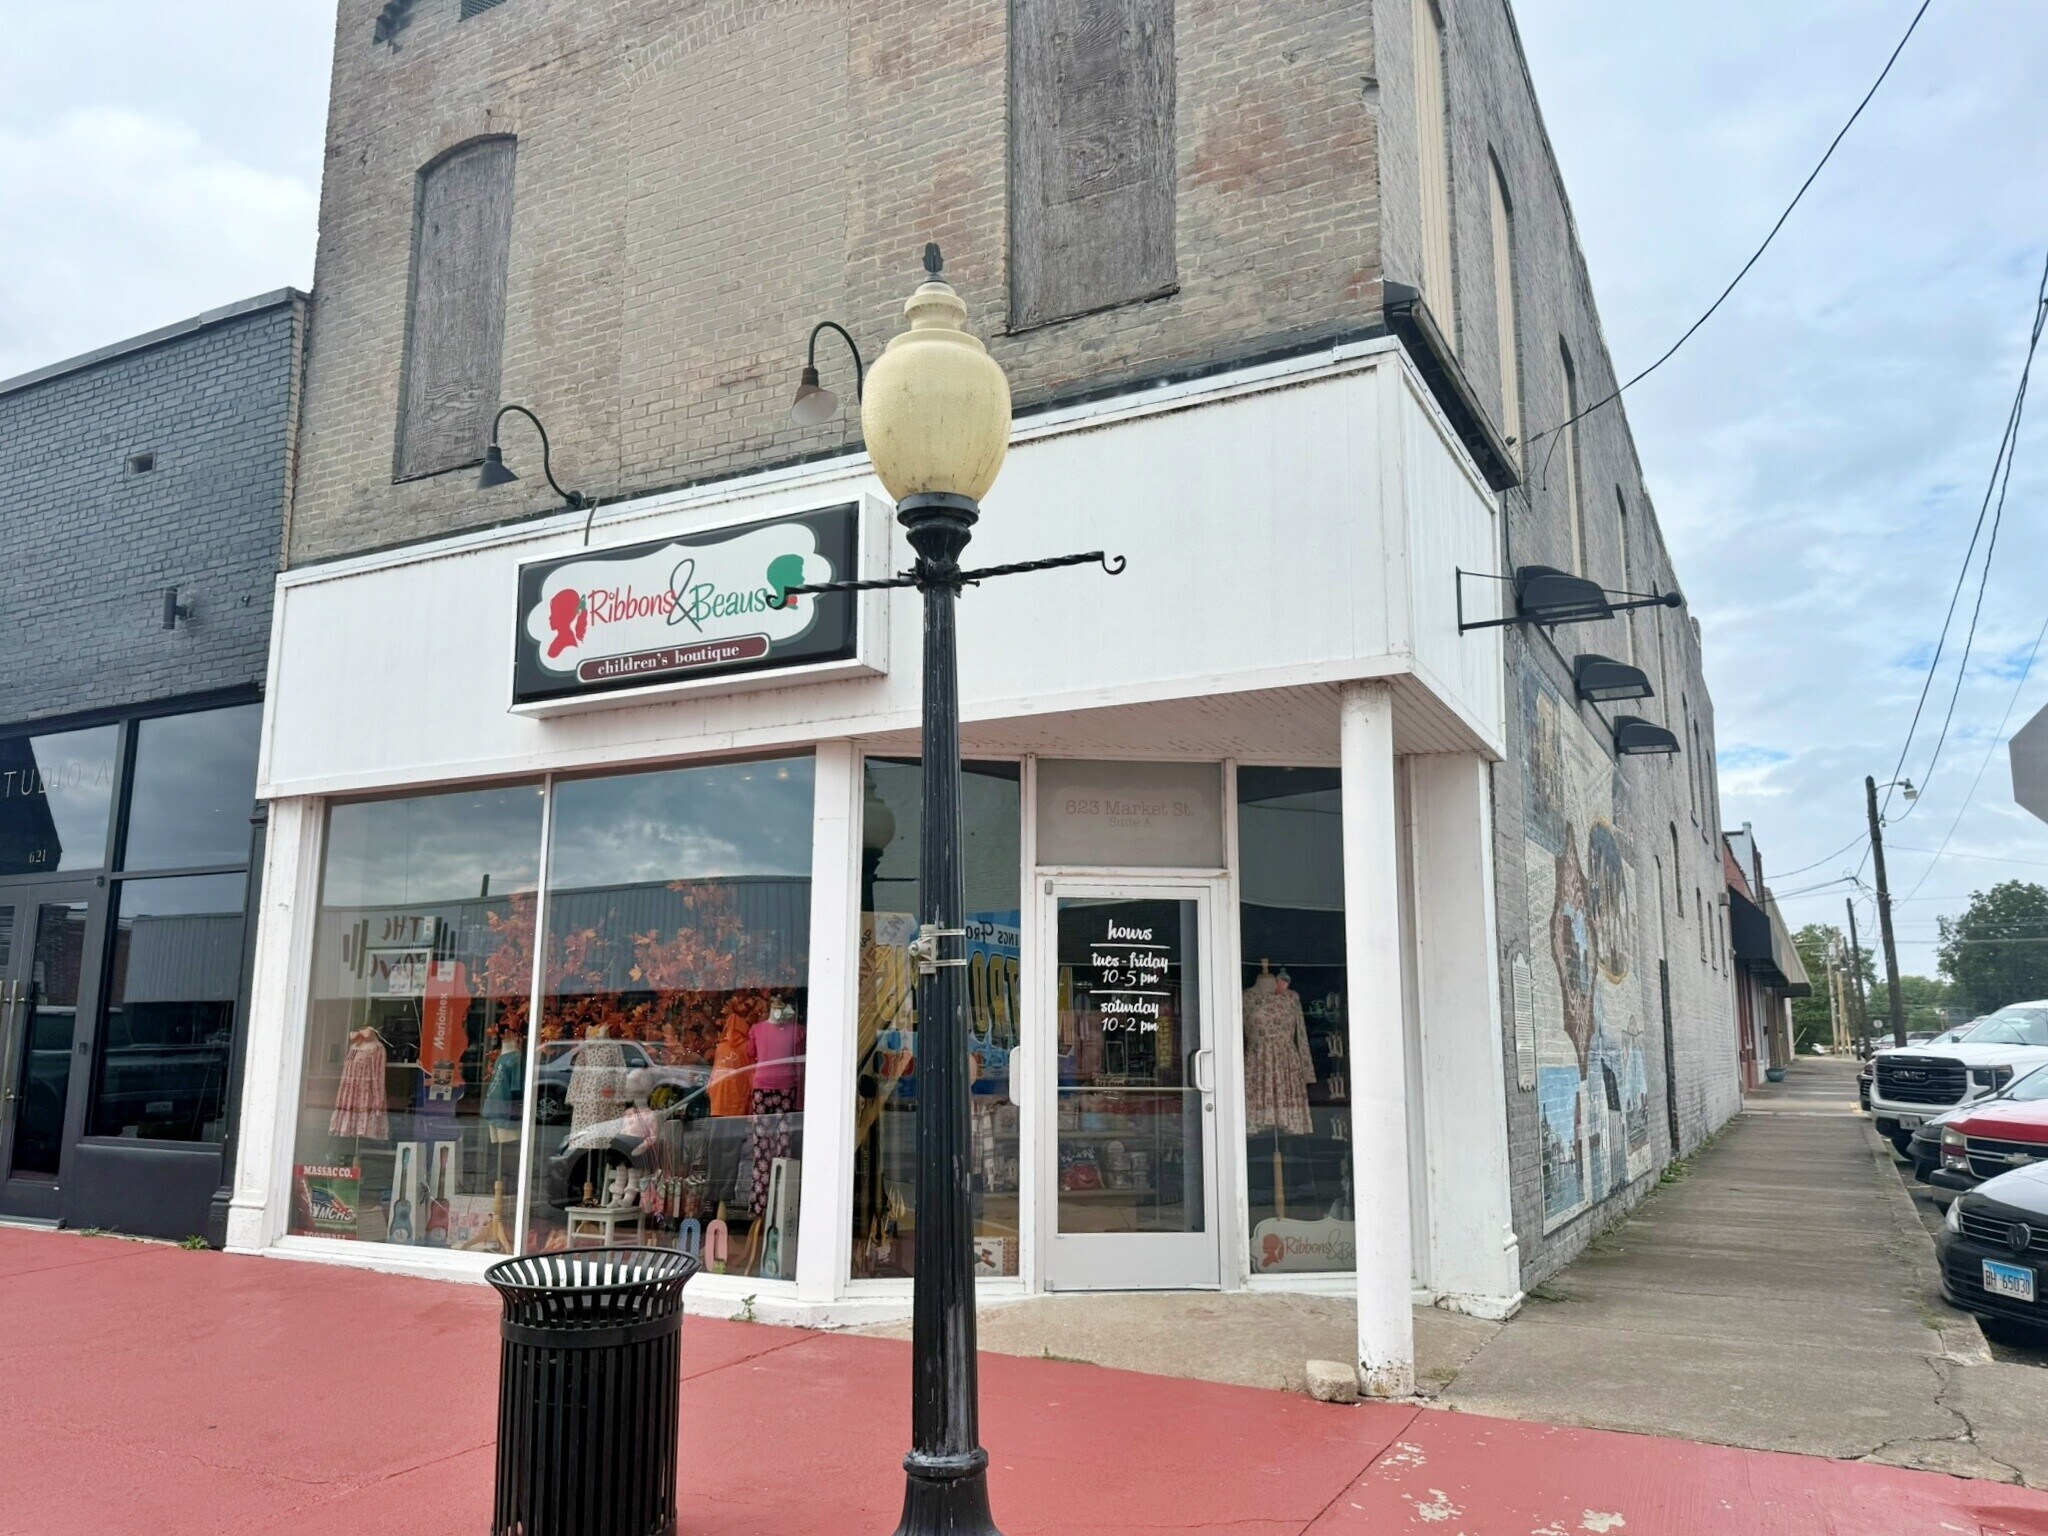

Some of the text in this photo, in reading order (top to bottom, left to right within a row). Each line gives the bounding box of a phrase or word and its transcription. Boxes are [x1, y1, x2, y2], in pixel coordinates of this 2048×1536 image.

[588, 559, 768, 633] Ribbons & Beaus
[597, 646, 740, 676] children's boutique
[1065, 800, 1195, 817] 623 Market St.
[1109, 817, 1140, 827] Suite
[28, 849, 46, 863] 621
[1107, 919, 1153, 940] hours
[1140, 972, 1160, 986] pm
[1100, 997, 1159, 1019] saturday
[433, 992, 448, 1051] Marioinex
[1140, 1020, 1160, 1034] pm
[303, 1165, 353, 1178] MASSAC CO.
[1285, 1236, 1331, 1255] Ribbons
[2002, 1274, 2031, 1295] 65030
